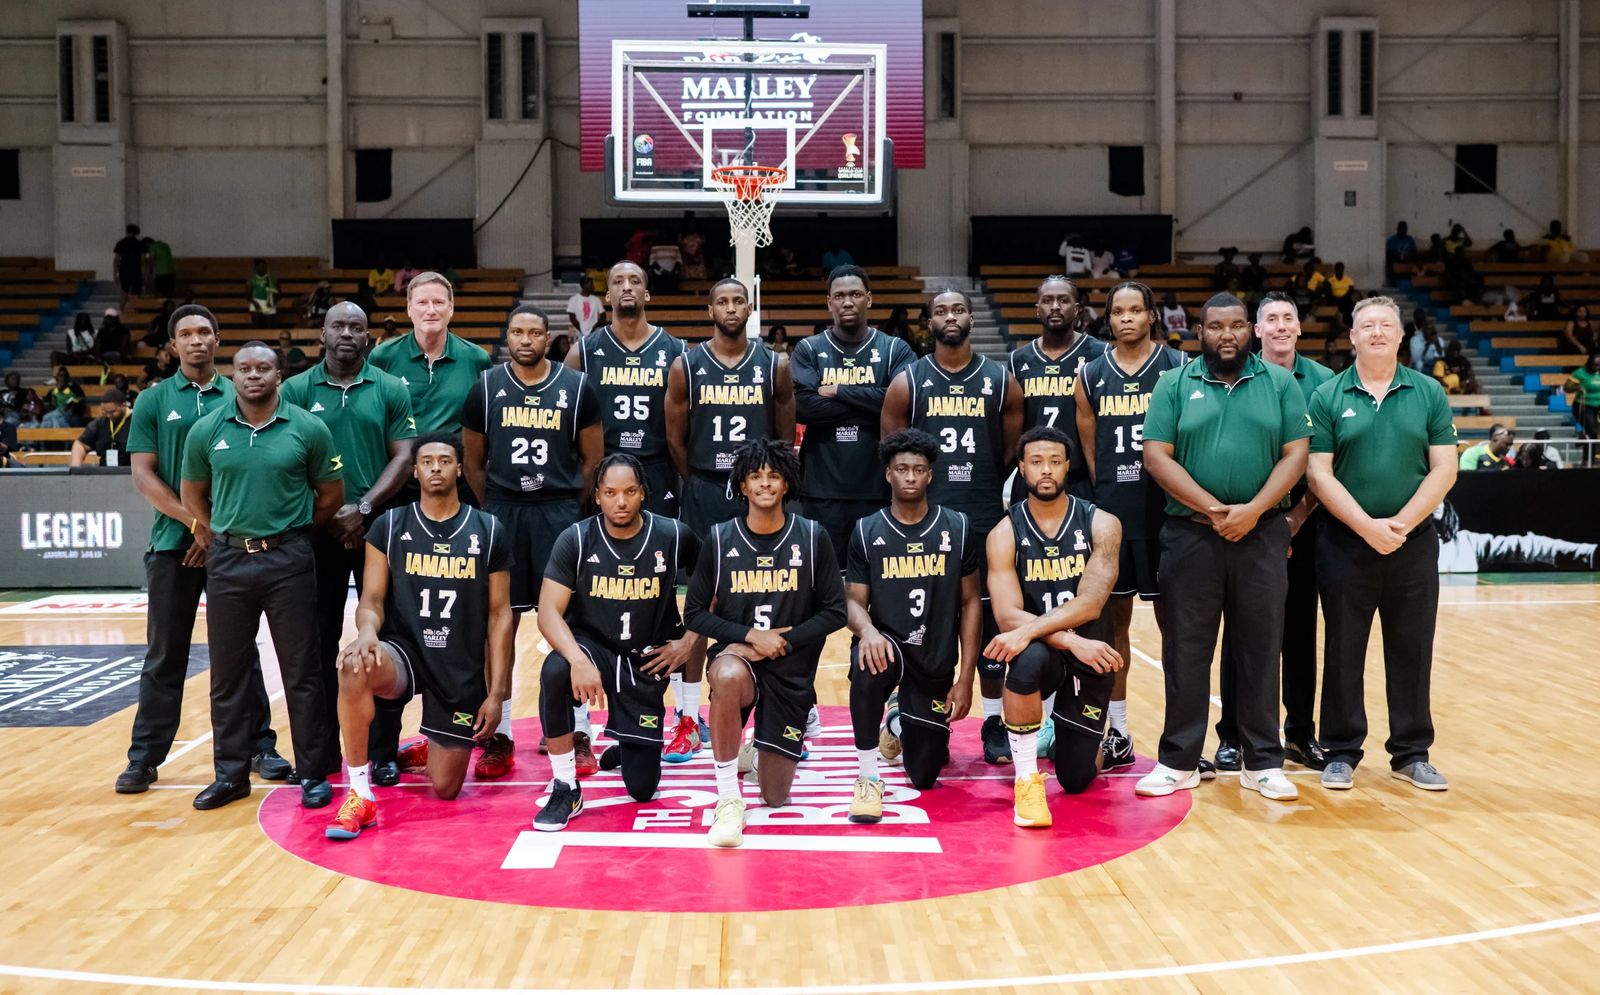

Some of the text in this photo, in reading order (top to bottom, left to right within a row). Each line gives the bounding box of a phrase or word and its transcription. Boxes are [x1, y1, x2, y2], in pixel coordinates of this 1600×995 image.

[636, 157, 653, 167] FIBA
[600, 366, 664, 387] JAMAICA
[821, 366, 876, 386] JAMAICA
[614, 395, 650, 421] 35
[699, 385, 764, 405] JAMAICA
[927, 397, 985, 417] JAMAICA
[1098, 392, 1153, 416] JAMAIC
[501, 406, 561, 430] JAMAICA
[712, 415, 747, 442] 12
[1043, 406, 1060, 429] 7
[511, 437, 549, 466] 23
[940, 427, 976, 454] 34
[1114, 424, 1144, 454] 15
[21, 511, 123, 550] LEGEND
[405, 552, 476, 579] JAMAICA
[882, 554, 946, 579] JAMAICA
[1025, 554, 1085, 582] JAMAICA
[590, 575, 660, 600] JAMAICA
[730, 568, 798, 594] JAMAICA
[419, 588, 458, 619] 17
[909, 588, 926, 618] 3
[620, 611, 632, 641] 1
[754, 605, 772, 630] 5
[21, 659, 145, 711] FOUNDATI
